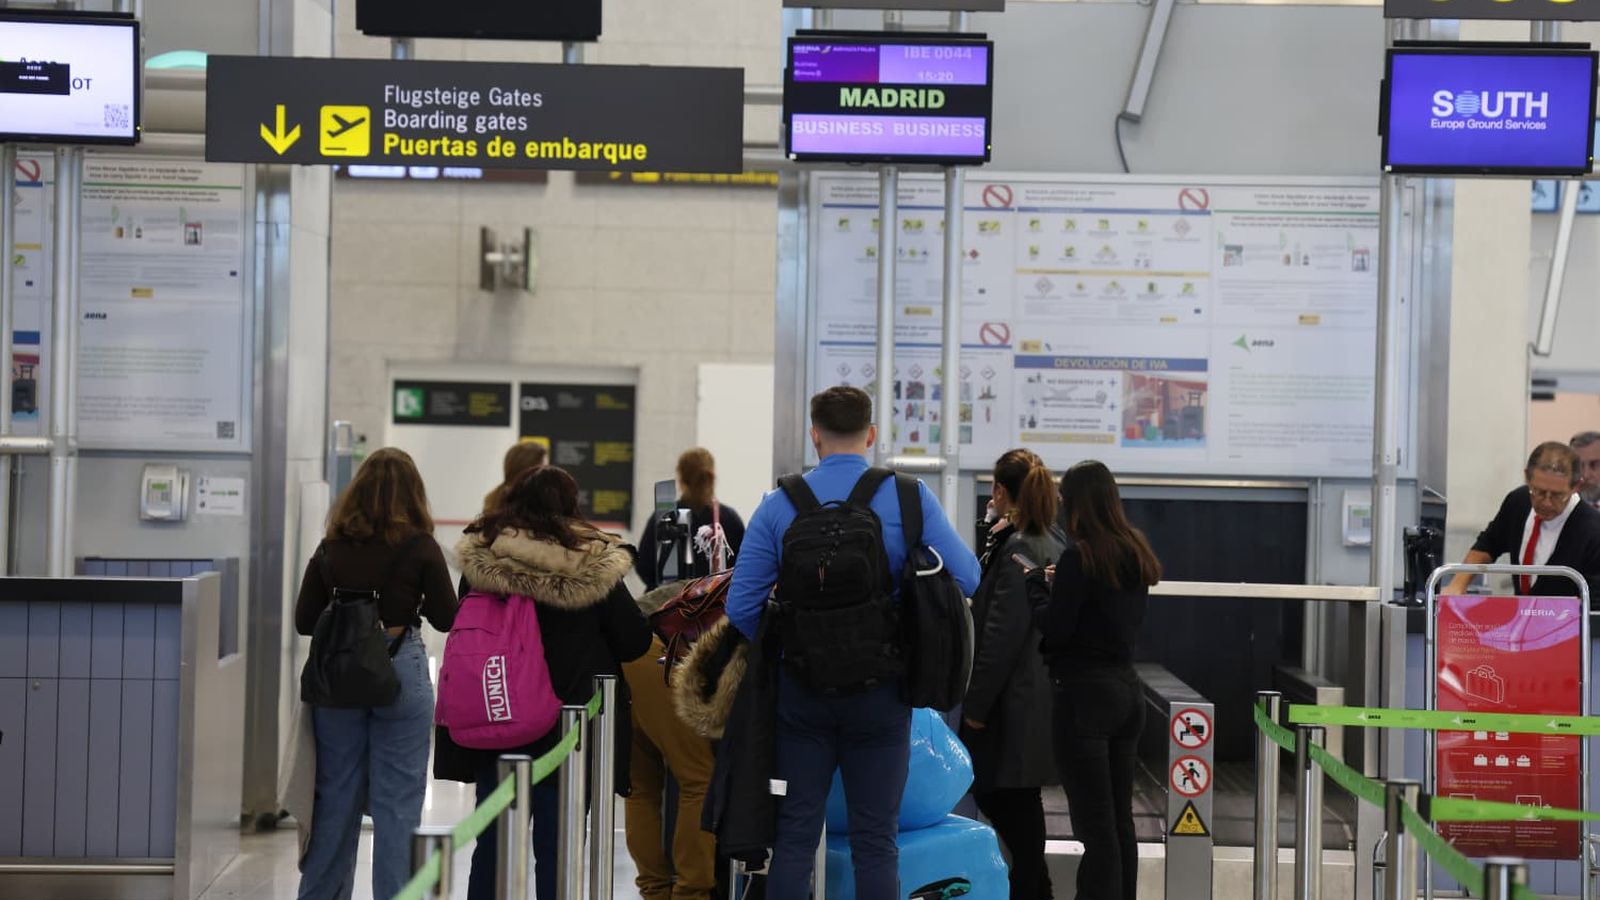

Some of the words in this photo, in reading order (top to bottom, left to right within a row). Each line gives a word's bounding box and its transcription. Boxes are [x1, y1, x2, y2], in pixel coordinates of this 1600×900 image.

[904, 47, 930, 59] IBE
[935, 47, 972, 60] 0044
[71, 78, 93, 90] OT
[384, 85, 481, 109] Flugsteige
[489, 87, 543, 107] Gates
[839, 87, 946, 109] MADRID
[1432, 89, 1549, 118] SOUTH
[384, 109, 468, 133] Boarding
[475, 112, 528, 133] gates
[792, 121, 884, 136] BUSINESS
[893, 122, 984, 138] BUSINESS
[1431, 118, 1465, 130] Europe
[1467, 118, 1503, 129] Ground
[1505, 119, 1546, 130] Services
[383, 133, 478, 157] Puertas
[487, 135, 516, 158] de
[525, 137, 648, 164] embarque
[1252, 339, 1275, 347] aena
[1131, 359, 1147, 369] DE
[1150, 359, 1169, 370] IVA
[1520, 608, 1556, 616] IBERIA
[486, 655, 506, 721] MUNICH
